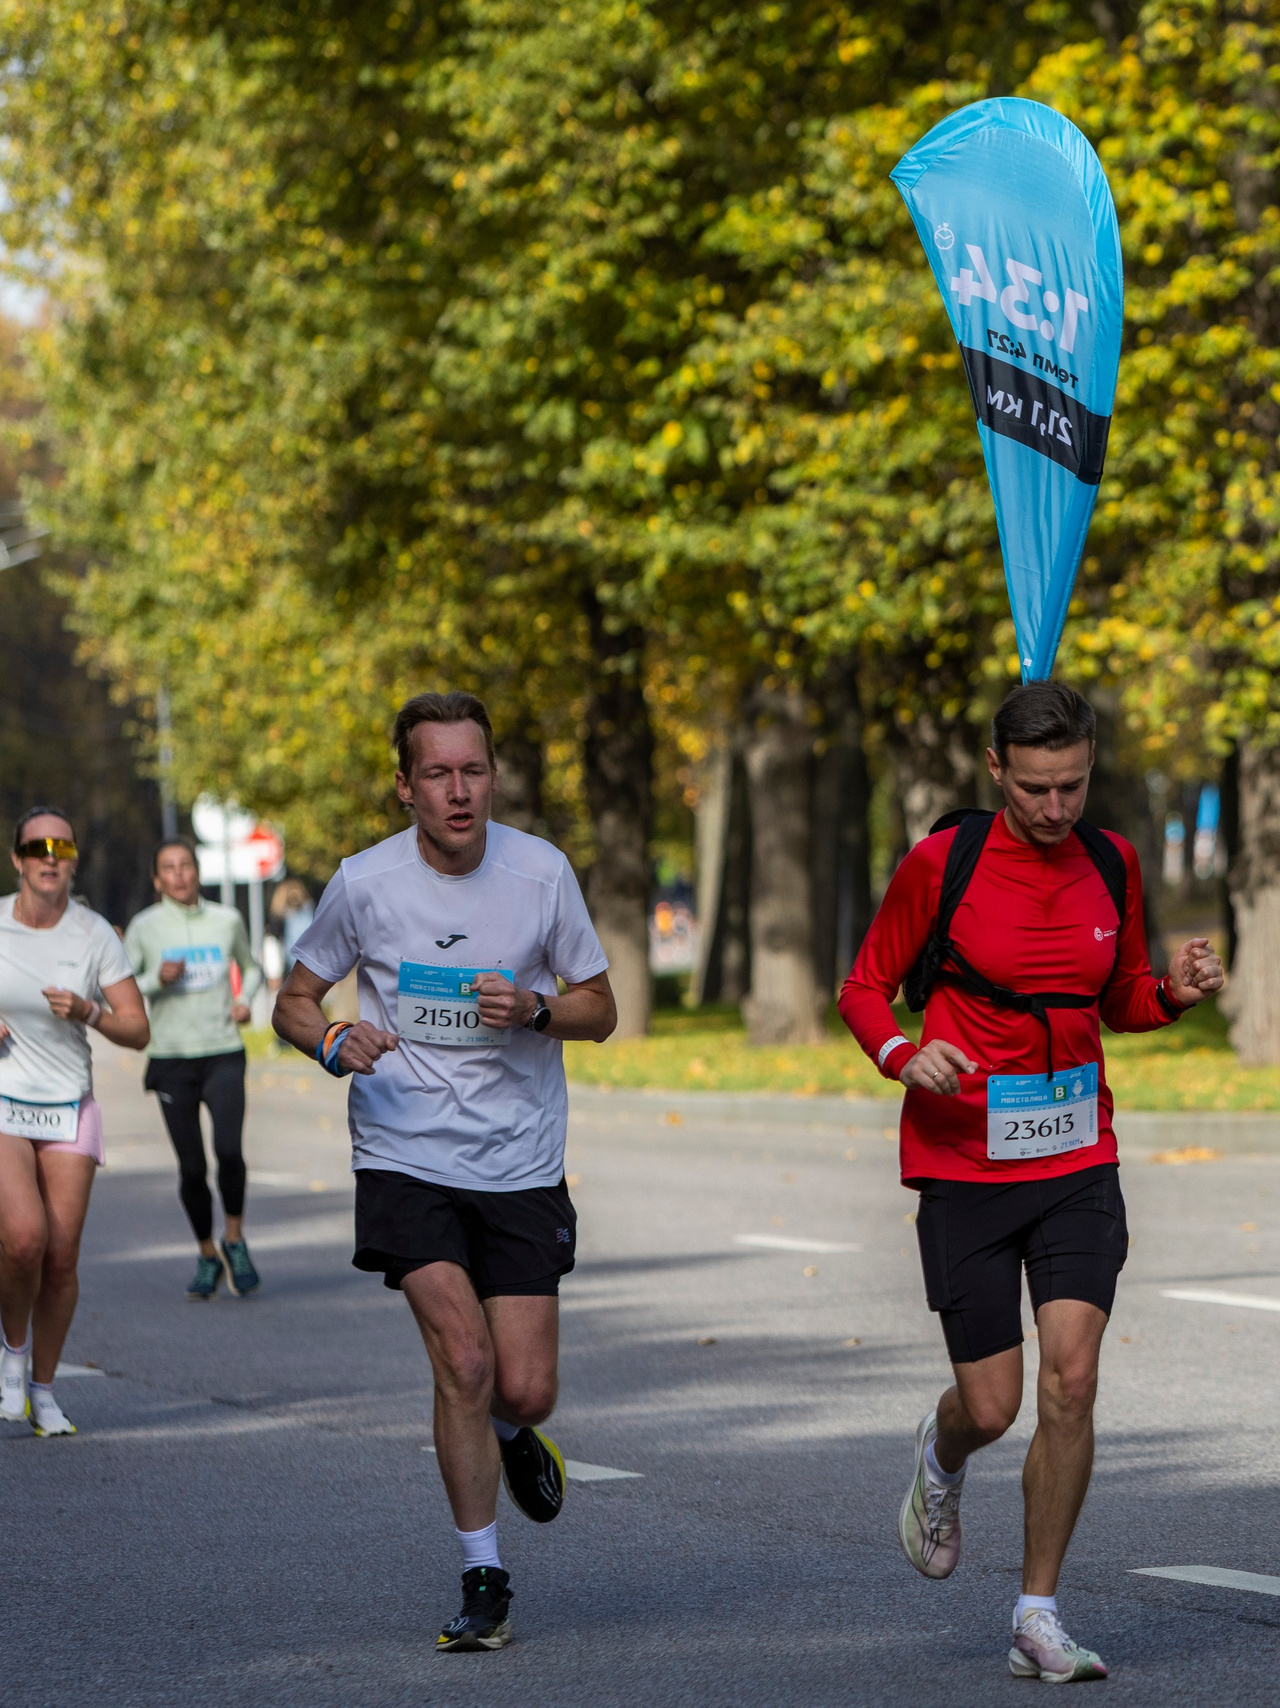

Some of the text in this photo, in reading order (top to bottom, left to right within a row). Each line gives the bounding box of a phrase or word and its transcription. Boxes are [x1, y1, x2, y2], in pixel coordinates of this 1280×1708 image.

[413, 1006, 480, 1029] 21510
[6, 1108, 61, 1128] 23200
[1004, 1112, 1074, 1141] 23613
